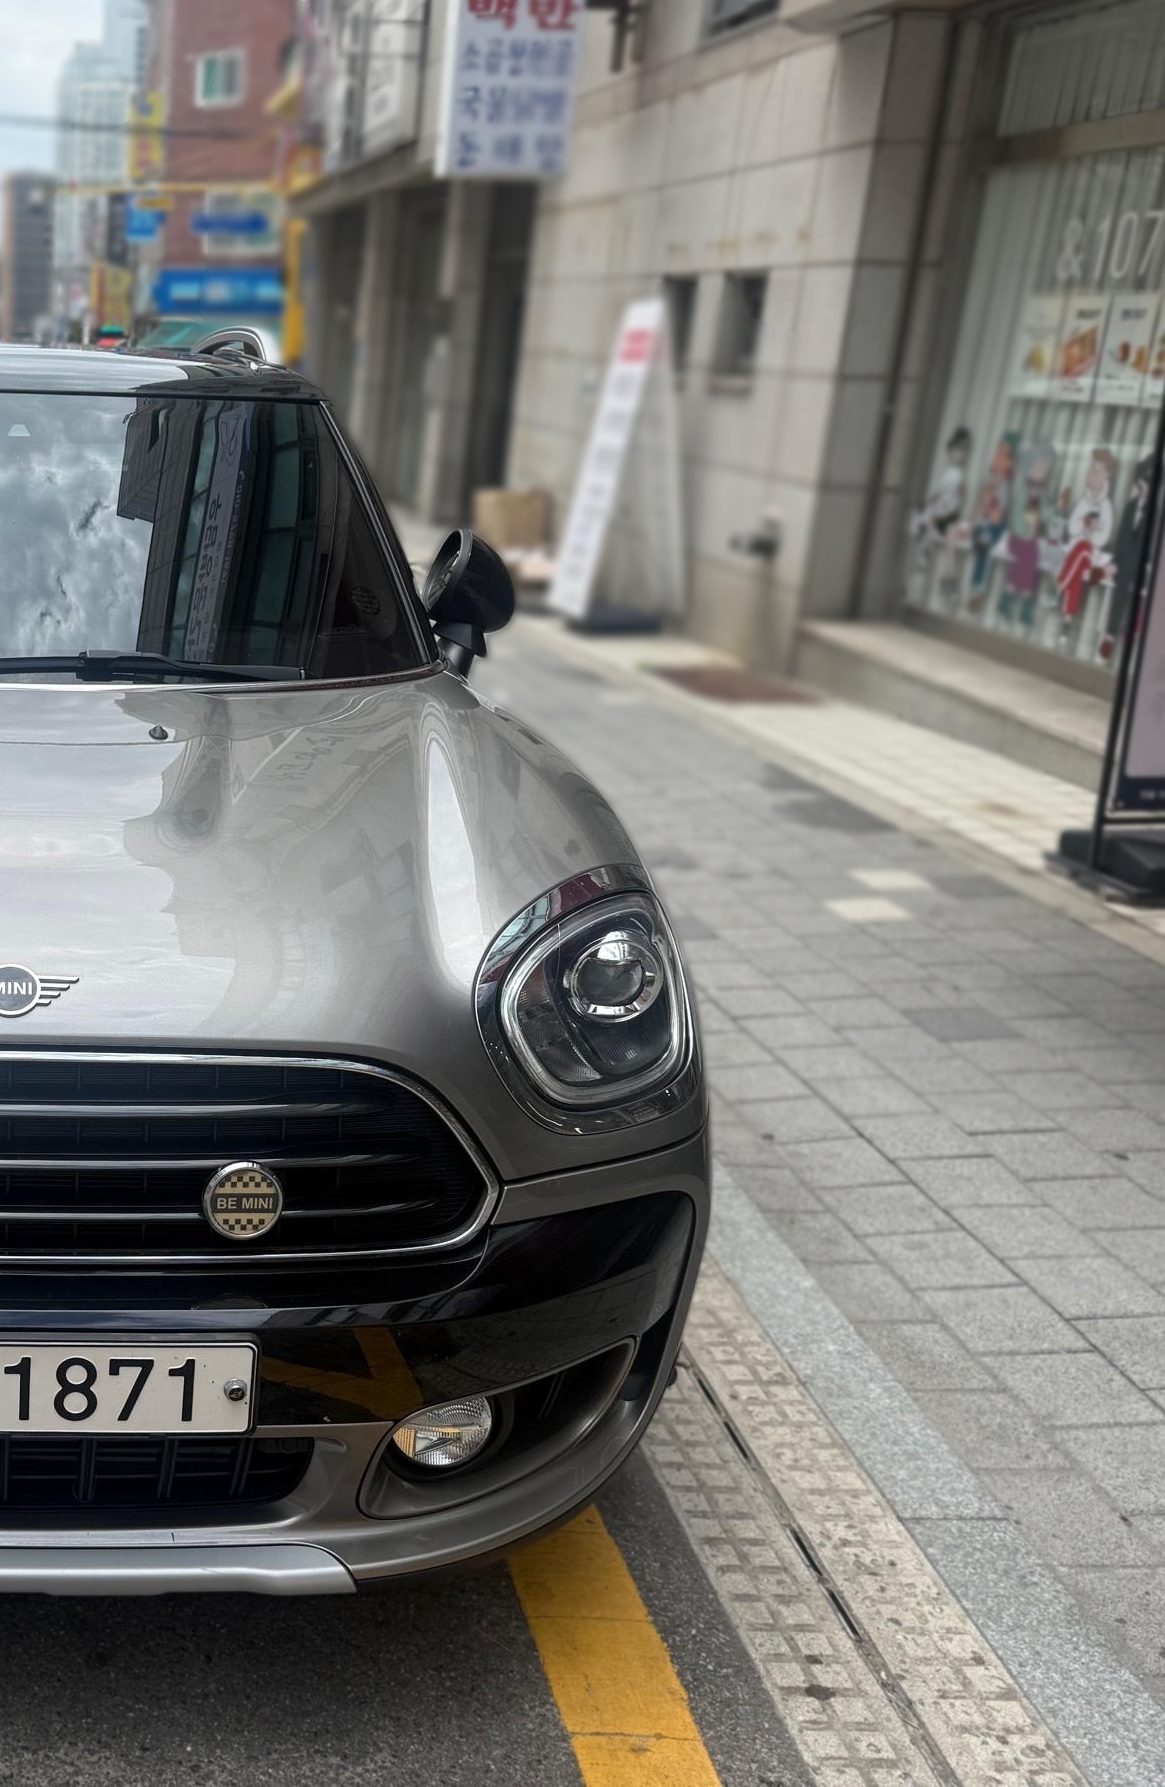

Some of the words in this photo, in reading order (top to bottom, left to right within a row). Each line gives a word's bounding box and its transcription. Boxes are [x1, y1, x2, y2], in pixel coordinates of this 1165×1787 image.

[216, 1197, 237, 1210] BE
[241, 1197, 273, 1210] MINI
[3, 1357, 196, 1421] 1871
